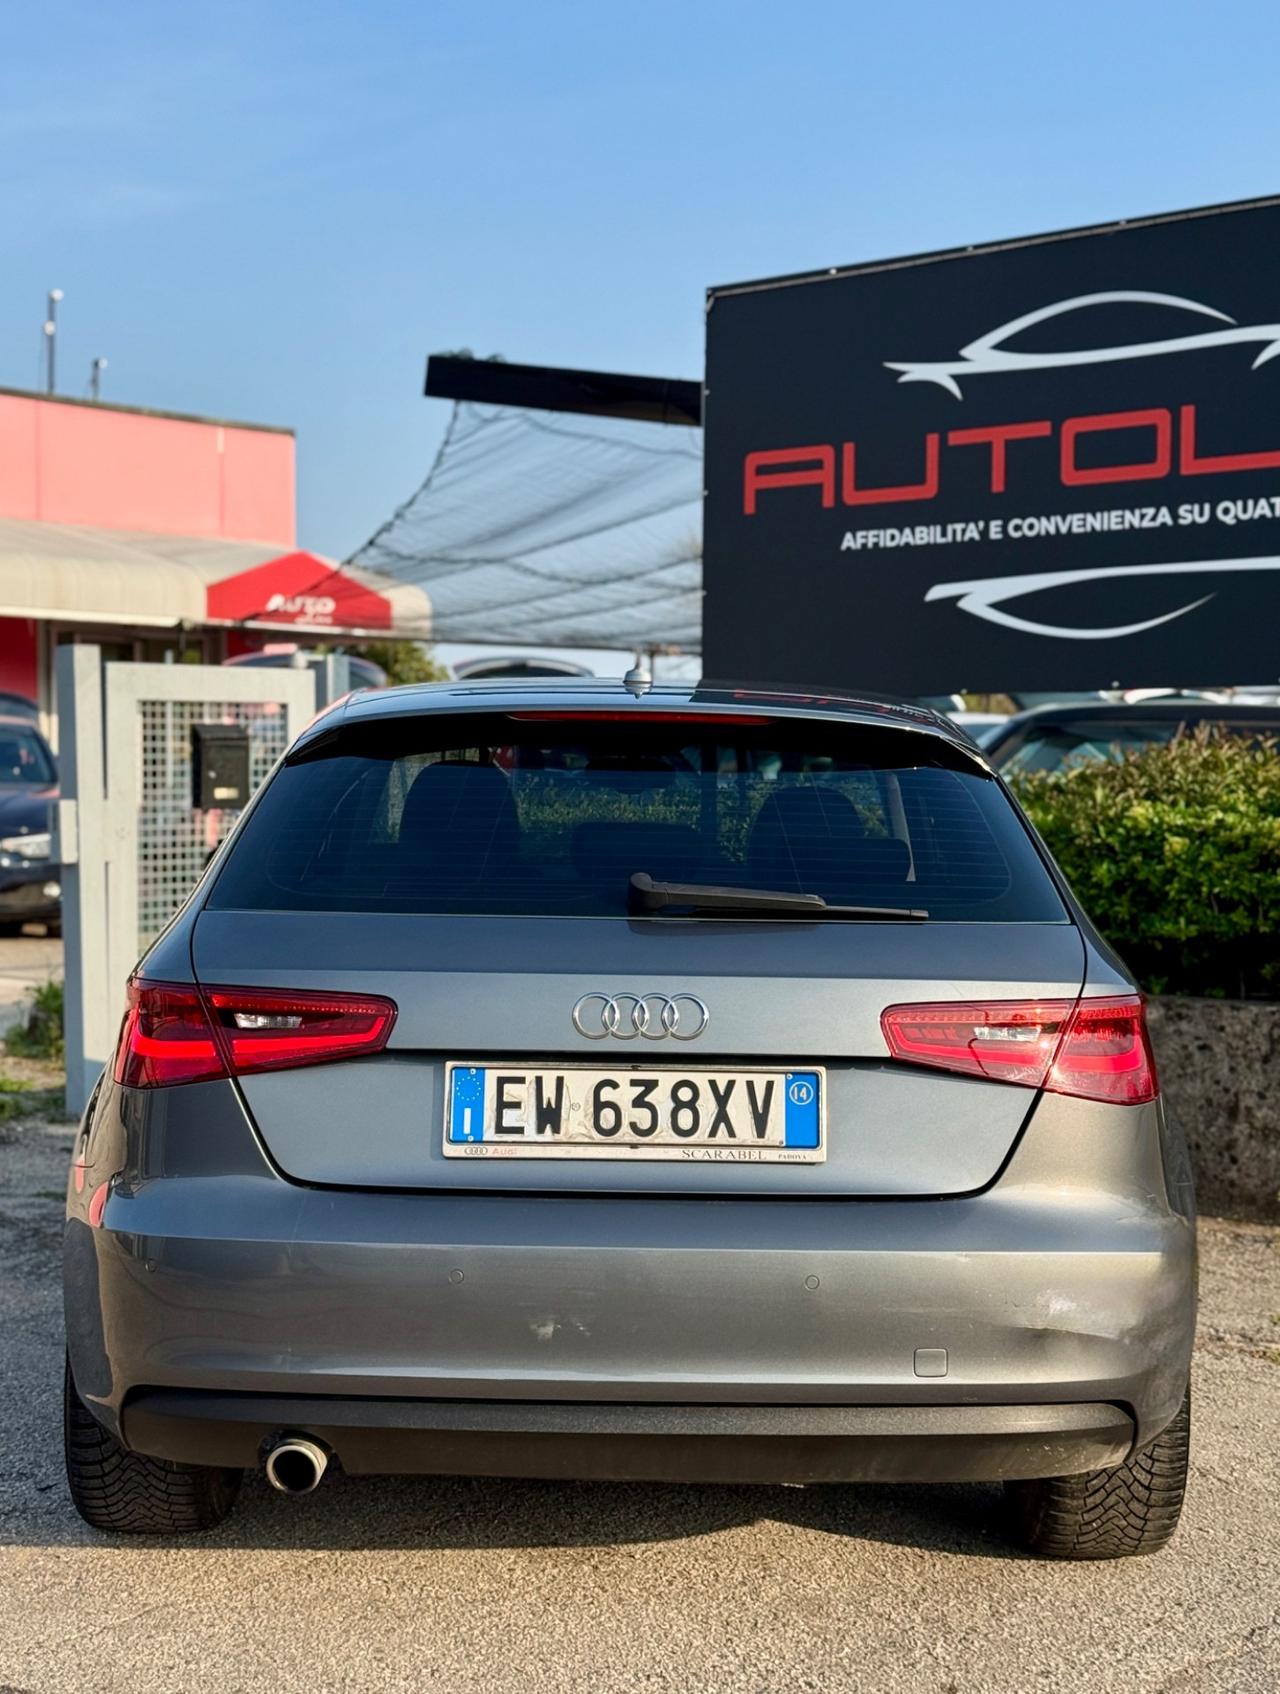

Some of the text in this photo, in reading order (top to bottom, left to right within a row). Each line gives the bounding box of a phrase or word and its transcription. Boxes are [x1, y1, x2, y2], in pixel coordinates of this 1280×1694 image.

[840, 520, 984, 551] AFFIDABILITA'
[988, 519, 1003, 540] E
[1007, 505, 1173, 538] CONVENIENZA
[1178, 502, 1211, 525] SU
[494, 1075, 775, 1139] EW 638XV
[793, 1086, 807, 1101] 14
[681, 1149, 767, 1161] SCARABEL
